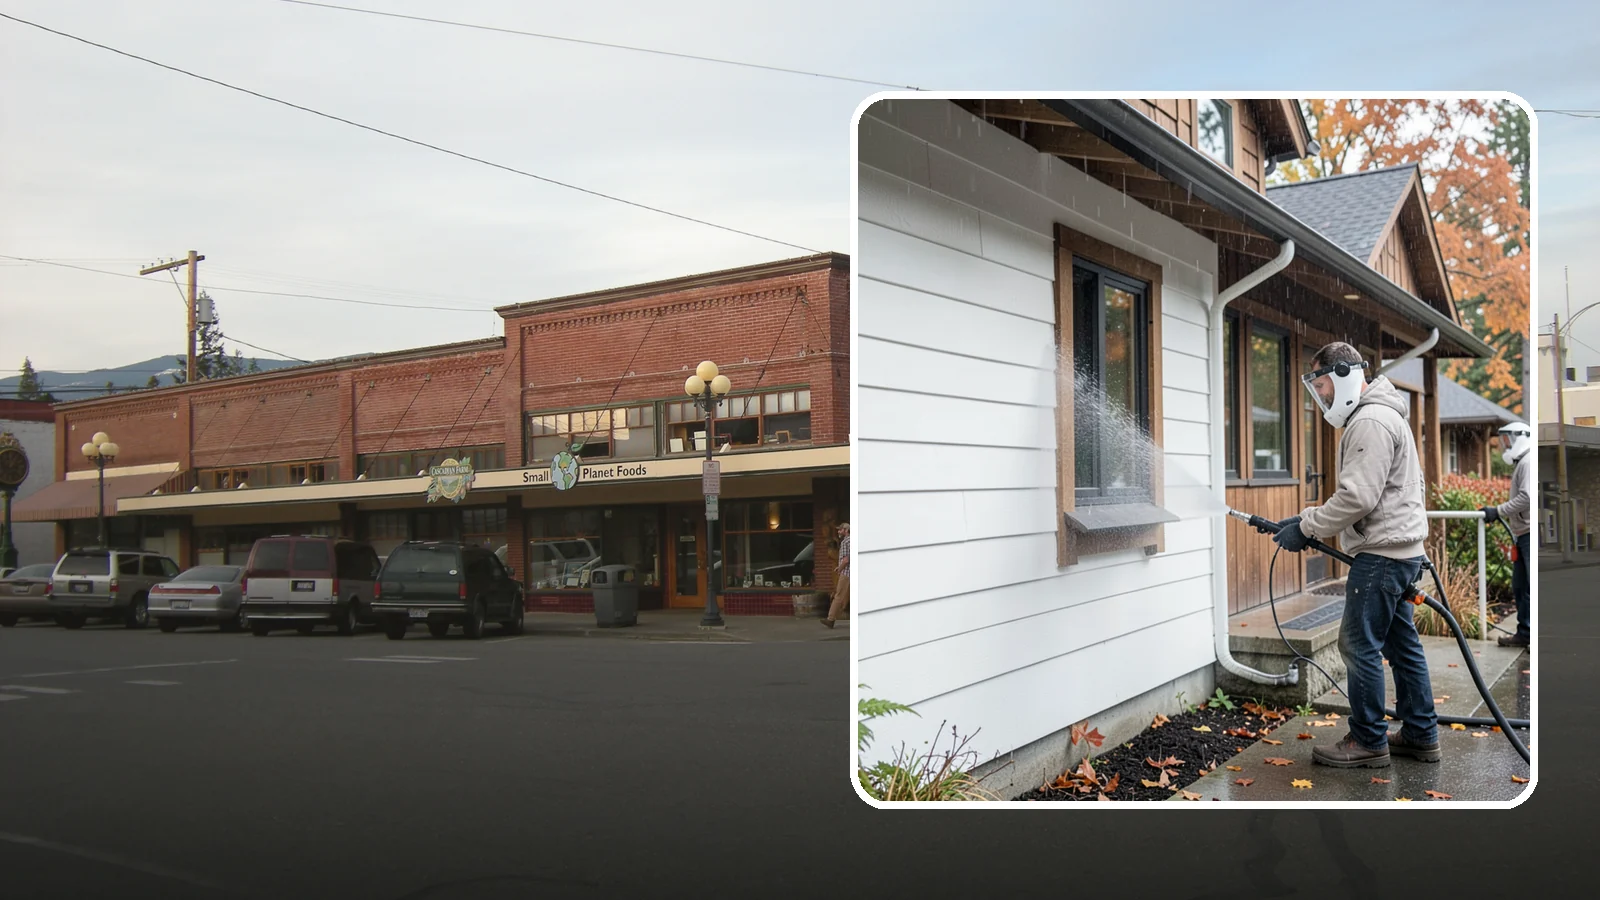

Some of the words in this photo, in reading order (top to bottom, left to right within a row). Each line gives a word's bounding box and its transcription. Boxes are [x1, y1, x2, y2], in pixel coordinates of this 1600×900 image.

[522, 470, 549, 483] Small
[582, 467, 614, 479] Planet
[616, 464, 647, 477] Foods
